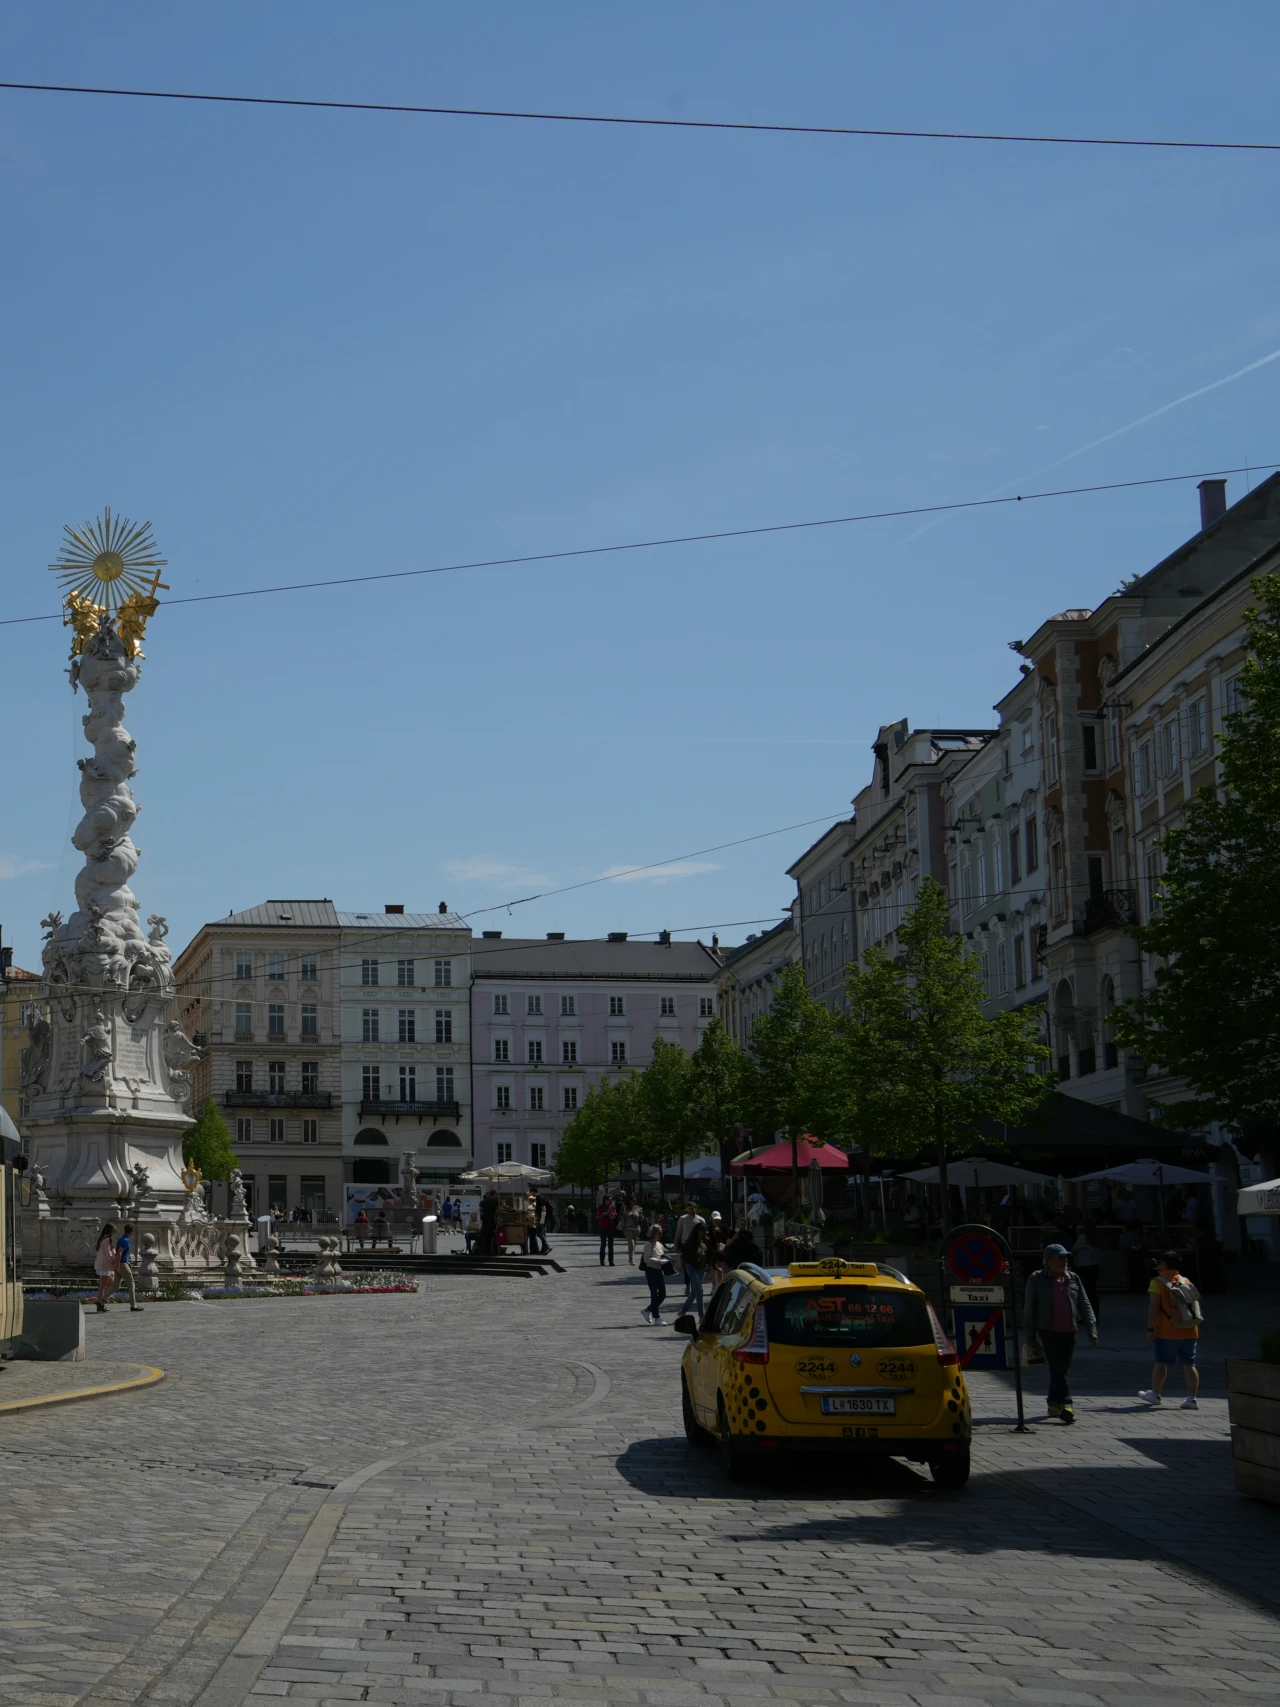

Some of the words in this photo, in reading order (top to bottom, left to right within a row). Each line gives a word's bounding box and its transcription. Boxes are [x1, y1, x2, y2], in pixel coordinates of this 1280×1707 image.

[1181, 1148, 1206, 1156] RIVA
[821, 1261, 847, 1269] 2244
[966, 1294, 989, 1302] Taxi
[805, 1296, 847, 1313] AST
[847, 1303, 862, 1312] 66
[864, 1304, 877, 1313] 12
[879, 1305, 895, 1314] 66
[798, 1362, 836, 1373] 2244
[879, 1362, 915, 1373] 2244
[832, 1400, 840, 1410] L
[848, 1400, 873, 1410] 1630
[876, 1400, 889, 1410] TX
